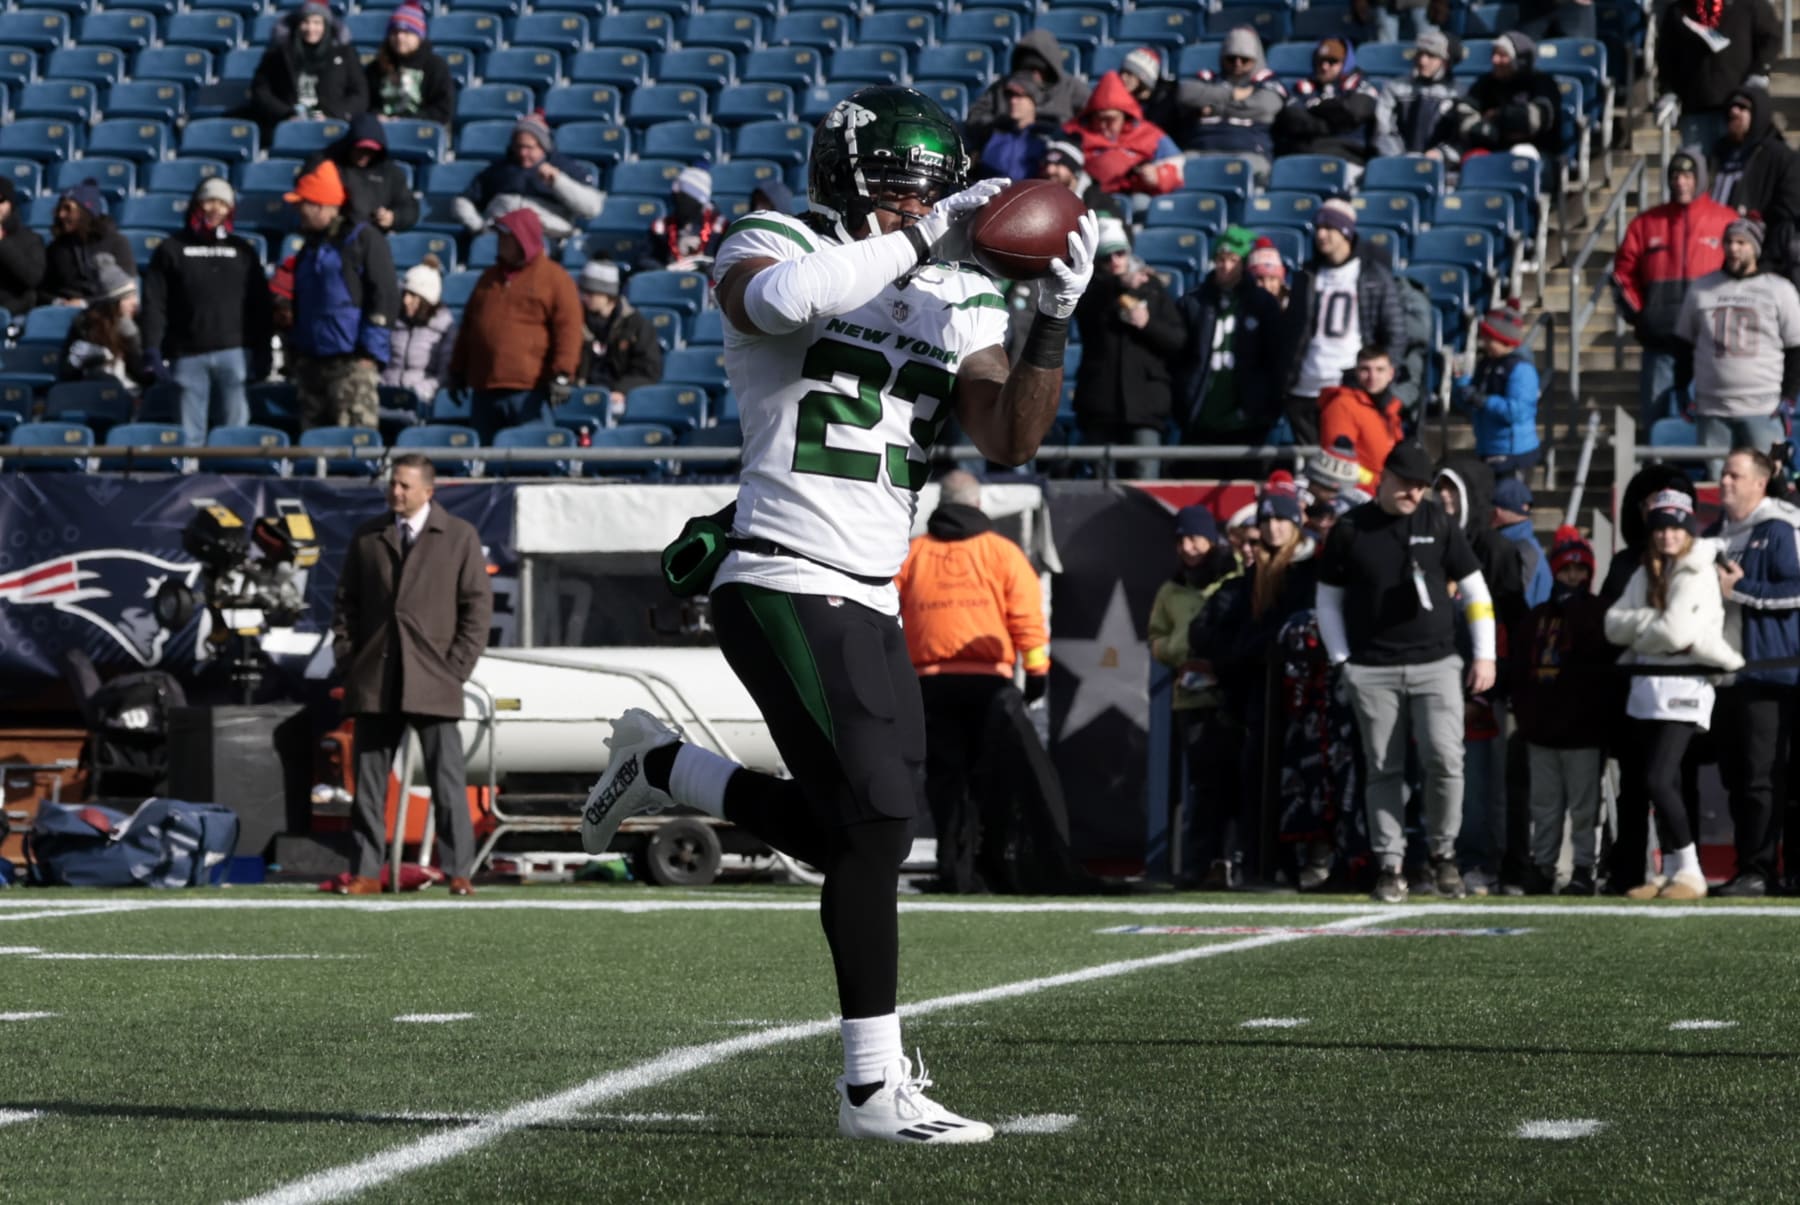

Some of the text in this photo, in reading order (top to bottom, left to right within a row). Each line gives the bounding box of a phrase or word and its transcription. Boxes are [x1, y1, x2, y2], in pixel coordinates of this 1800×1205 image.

[825, 317, 958, 365] NEW YORK
[791, 336, 957, 493] 23
